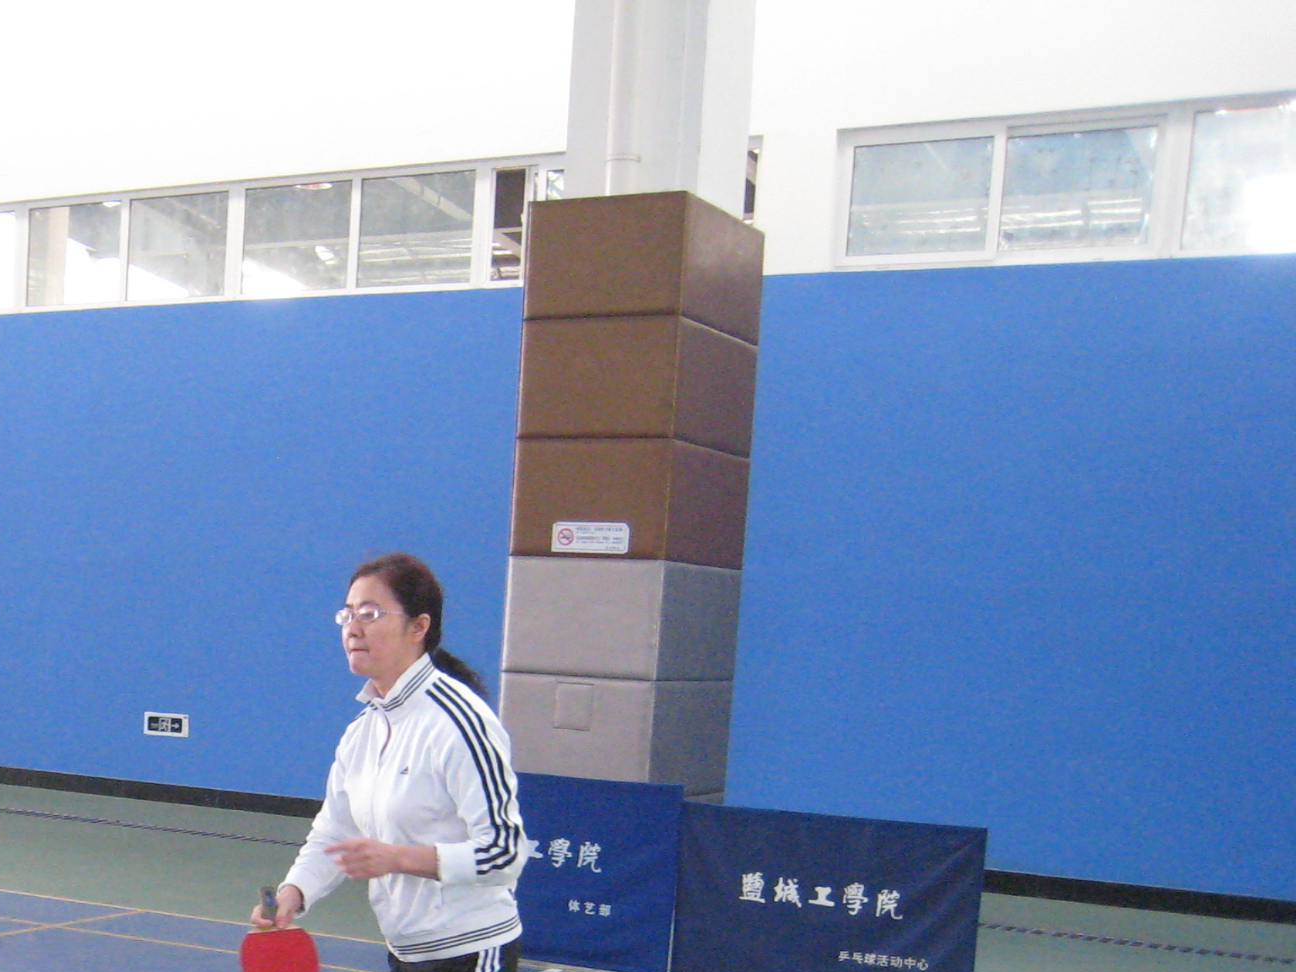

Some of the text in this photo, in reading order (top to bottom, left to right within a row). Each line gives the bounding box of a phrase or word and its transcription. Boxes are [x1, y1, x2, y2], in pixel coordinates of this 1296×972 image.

[837, 950, 930, 972] 乒乓球活动中心
